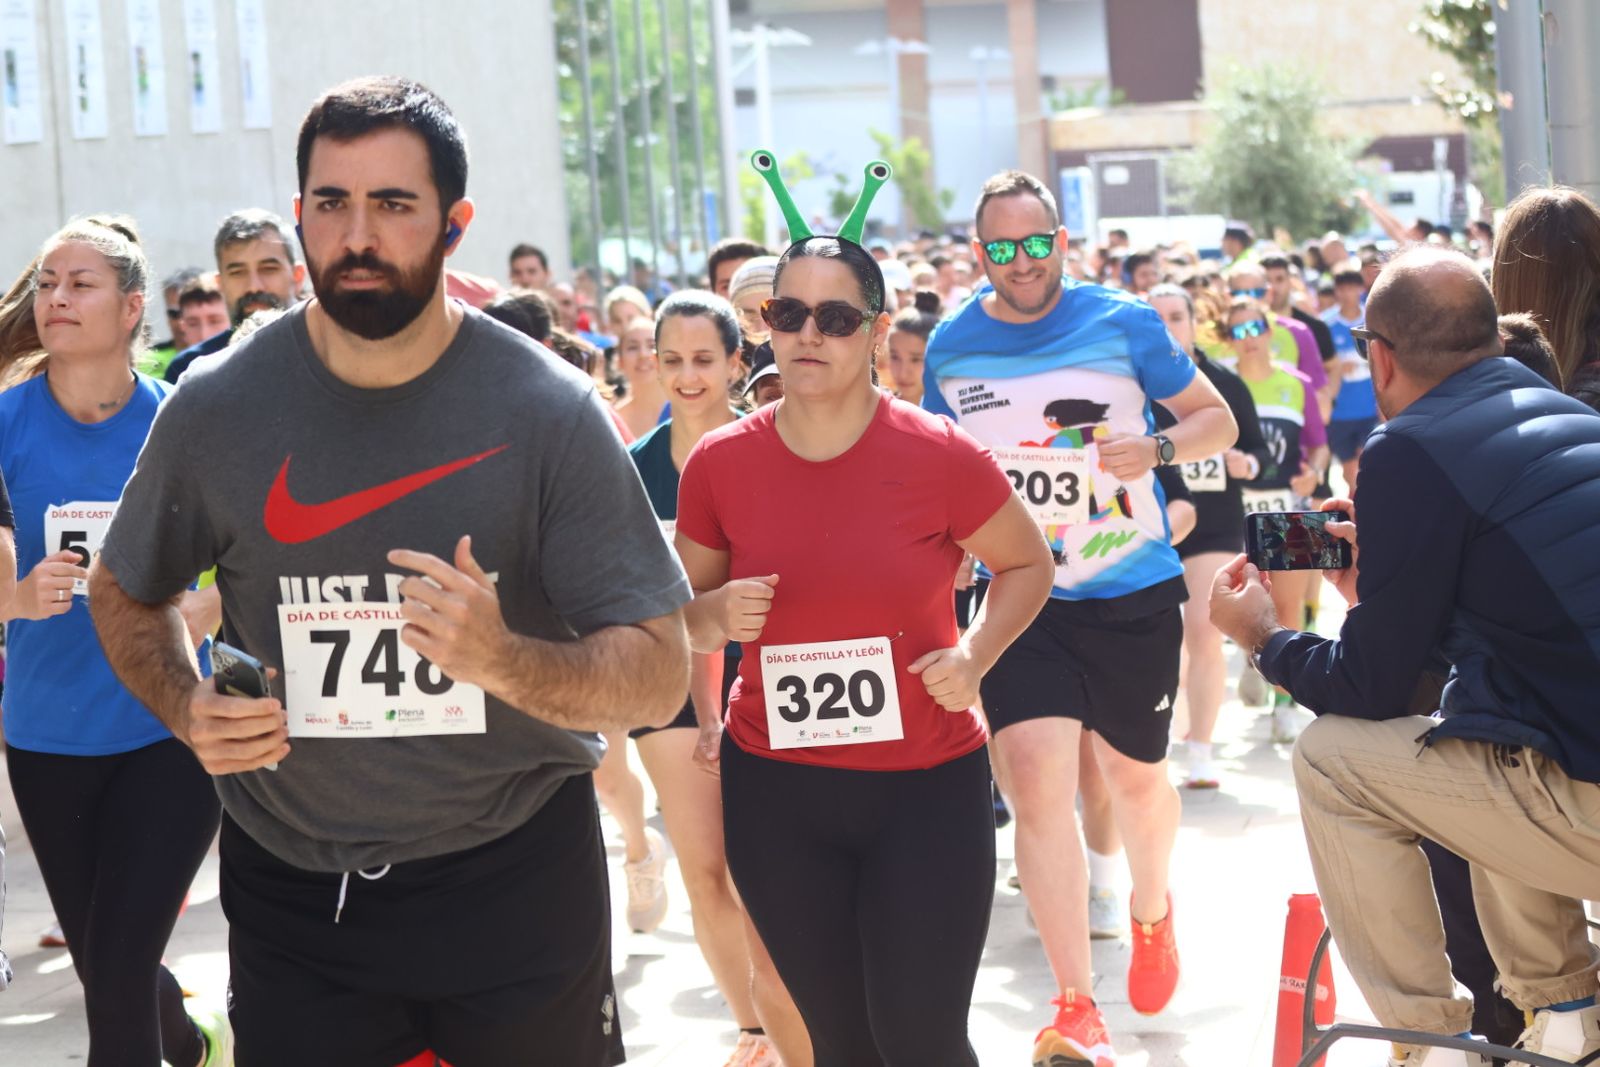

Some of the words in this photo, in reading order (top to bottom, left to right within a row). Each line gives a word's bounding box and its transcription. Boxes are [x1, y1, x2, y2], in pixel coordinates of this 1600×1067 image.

[969, 384, 984, 394] SAN
[1022, 454, 1055, 462] CASTILLA
[1006, 469, 1080, 507] 203
[71, 511, 84, 519] DE
[287, 610, 314, 623] DÍA
[319, 611, 339, 621] DE
[766, 653, 783, 664] DÍA
[785, 654, 798, 663] DE
[800, 650, 845, 662] CASTILLA
[846, 649, 853, 658] Y
[855, 646, 884, 658] LEÓN
[776, 669, 886, 723] 320
